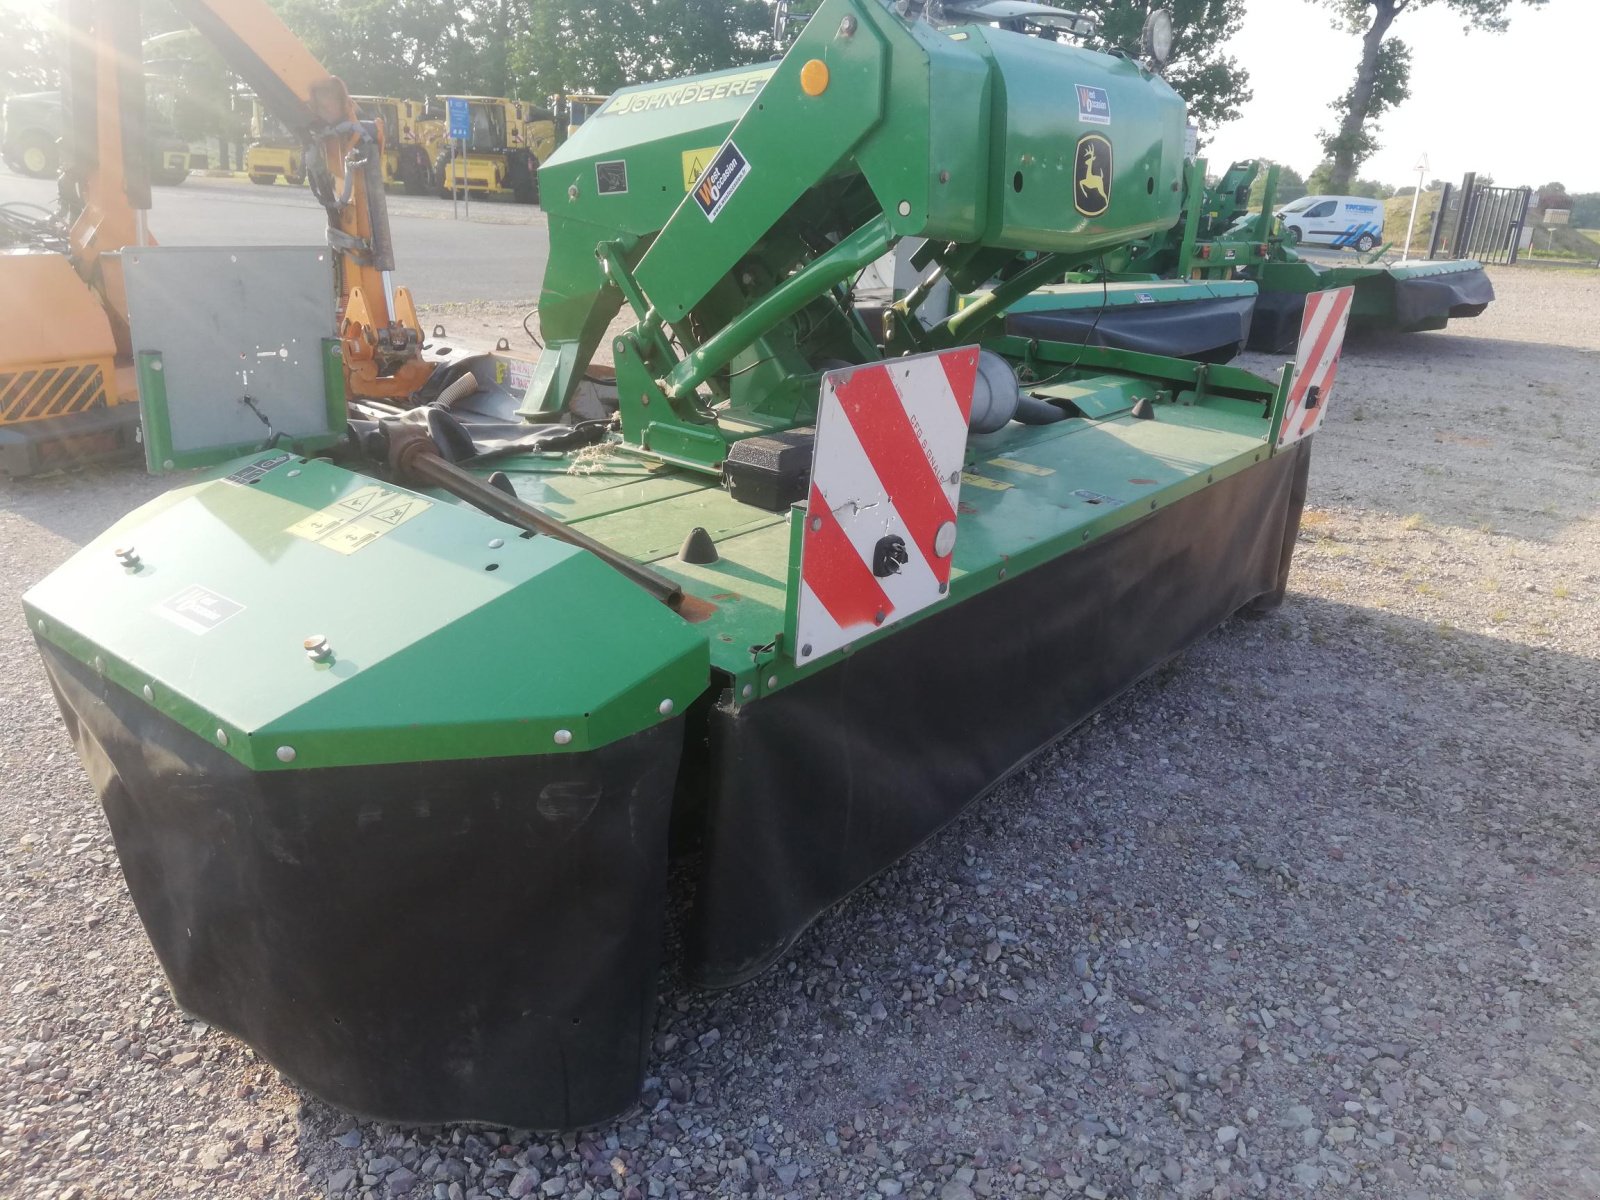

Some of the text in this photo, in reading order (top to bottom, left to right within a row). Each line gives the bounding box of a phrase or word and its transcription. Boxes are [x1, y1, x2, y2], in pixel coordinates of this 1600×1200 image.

[618, 78, 760, 115] JOHN DEERE
[698, 167, 722, 207] West
[710, 157, 738, 202] Occasion
